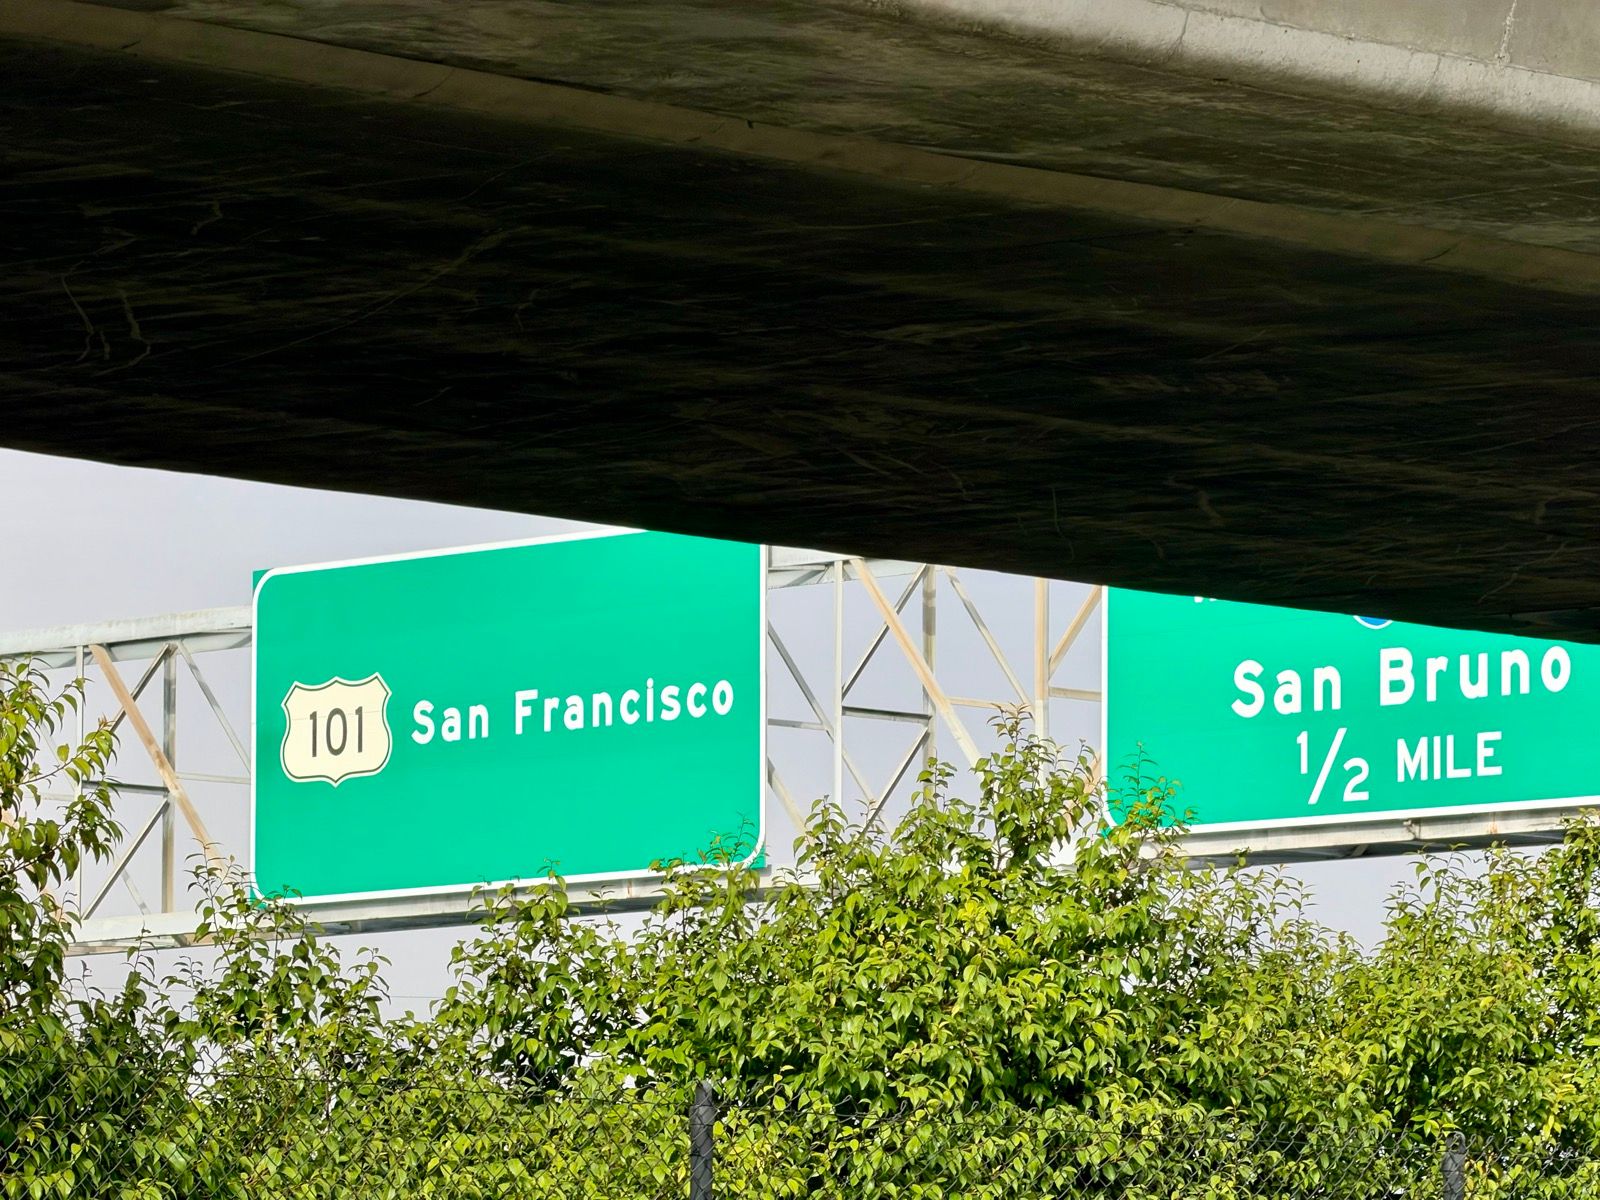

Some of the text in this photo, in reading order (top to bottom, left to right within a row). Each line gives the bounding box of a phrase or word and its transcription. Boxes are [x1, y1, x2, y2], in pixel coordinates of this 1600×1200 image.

[411, 677, 734, 745] San Francisco
[1231, 645, 1571, 718] San Bruno
[308, 706, 364, 758] 101
[1296, 727, 1503, 805] 1/2 MILE
